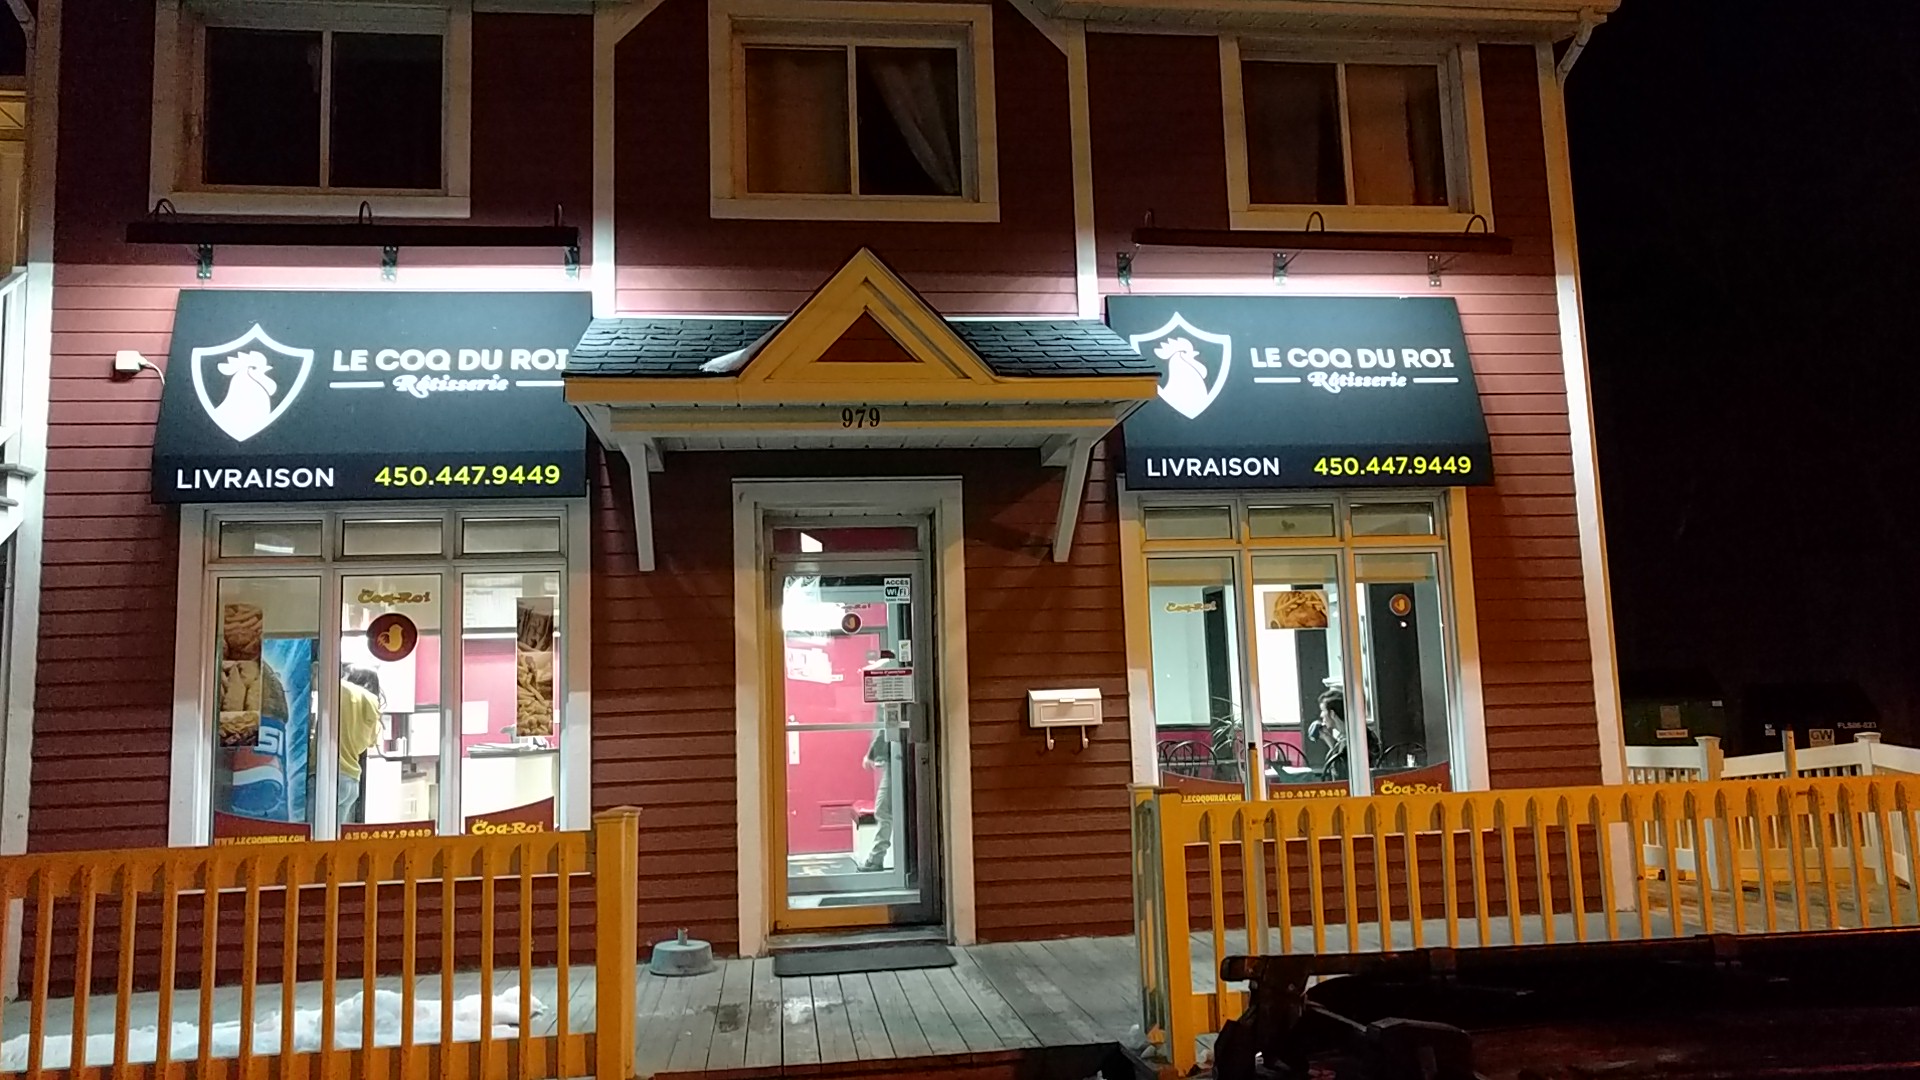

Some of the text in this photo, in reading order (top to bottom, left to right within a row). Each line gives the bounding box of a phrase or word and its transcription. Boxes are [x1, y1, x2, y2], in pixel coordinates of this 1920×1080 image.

[333, 348, 569, 371] LE COQ DU ROI
[1250, 347, 1454, 369] LE COQ DU ROI
[392, 373, 509, 399] Rôtisserie
[1307, 371, 1407, 394] Rôtisserie
[841, 407, 880, 428] 979
[374, 464, 561, 487] 450.447.9449
[1146, 456, 1280, 478] LIVRAISON
[1313, 455, 1472, 476] 450.447.9449
[176, 467, 335, 490] LIVRAISON
[1273, 788, 1347, 799] 450.447.9449
[344, 828, 432, 841] 450.447.9449
